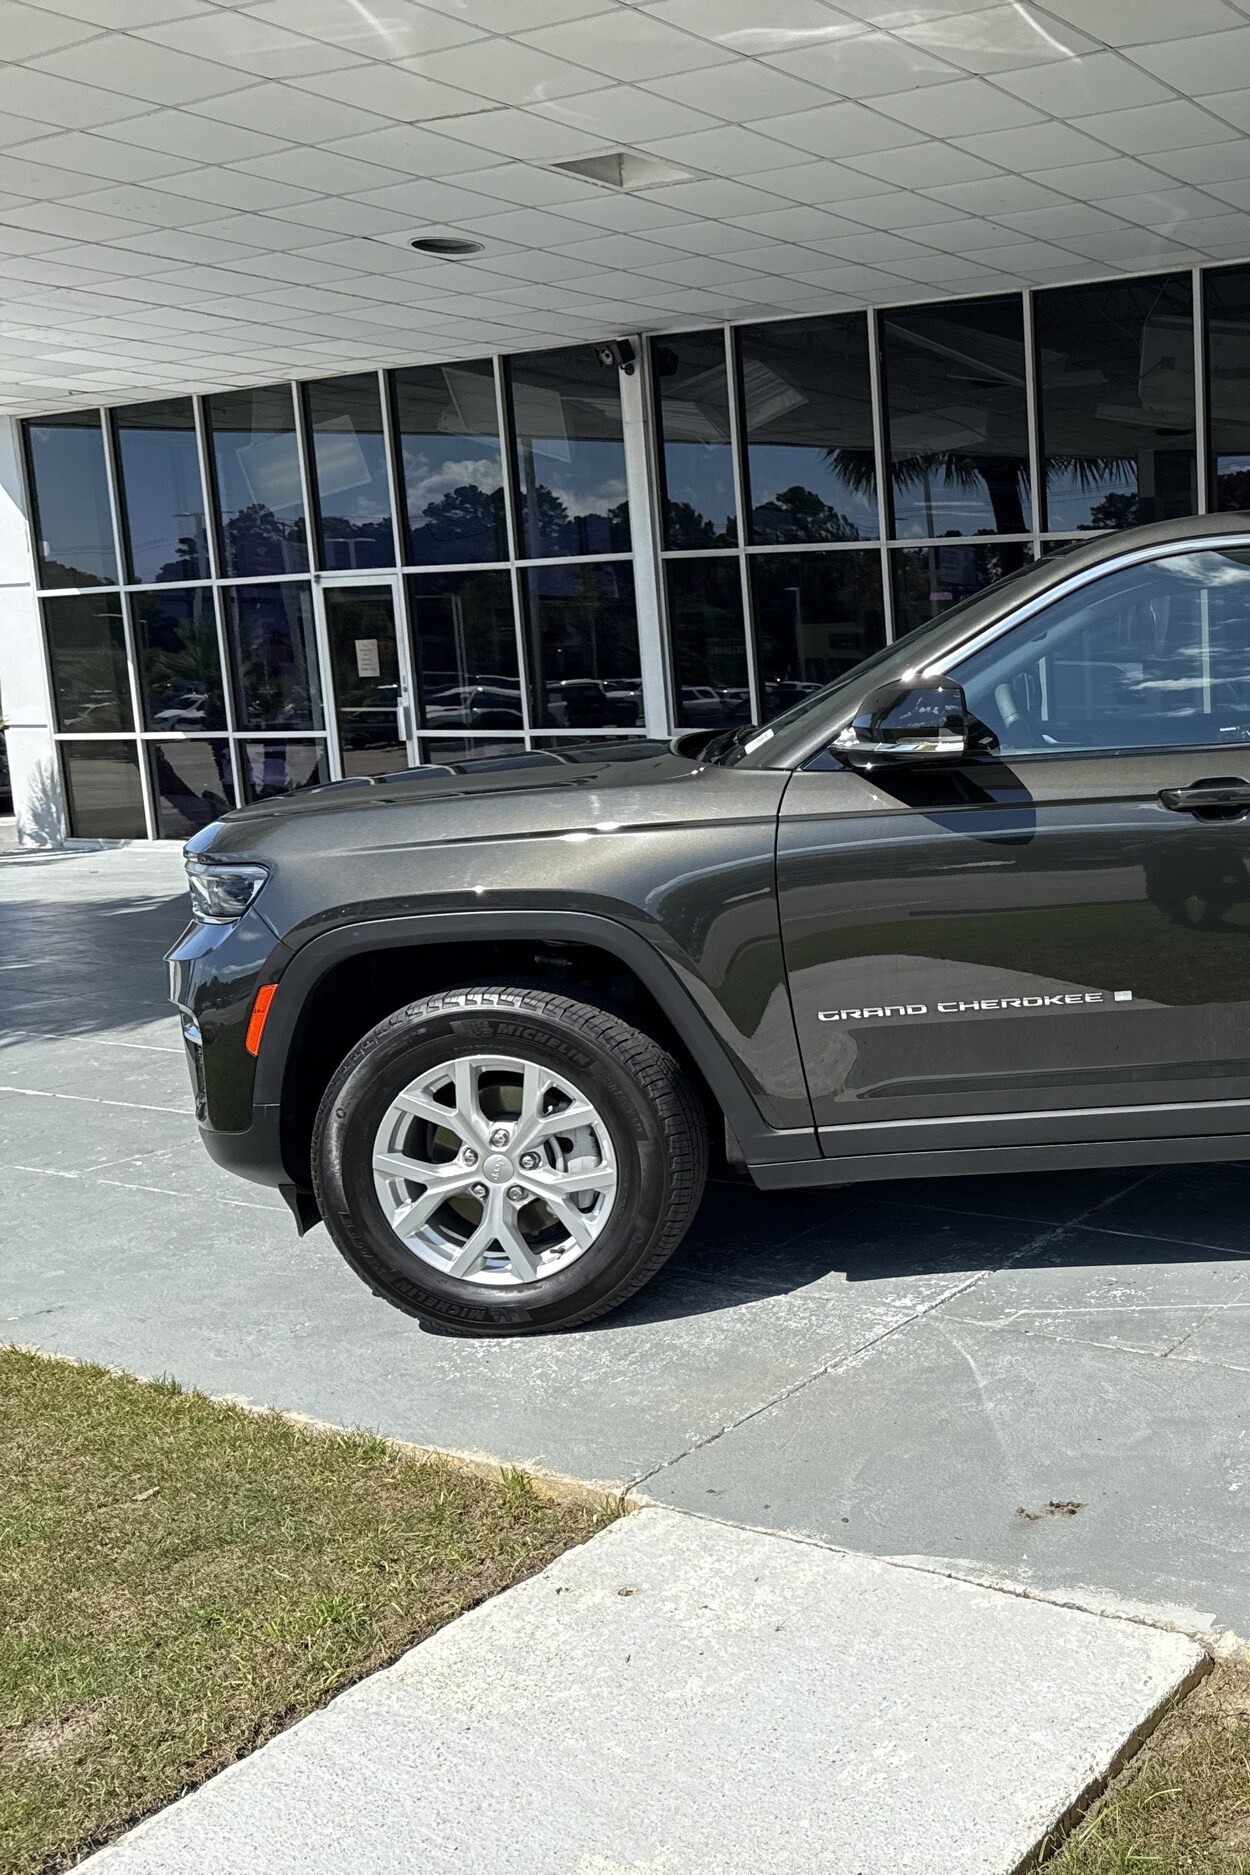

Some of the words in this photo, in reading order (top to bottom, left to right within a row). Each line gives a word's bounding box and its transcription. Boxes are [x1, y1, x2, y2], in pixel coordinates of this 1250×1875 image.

[818, 1004, 928, 1022] GRAND
[937, 992, 1104, 1013] CHEROKEE
[497, 1023, 592, 1066] MICHELIN
[397, 1278, 488, 1321] MICHELIN
